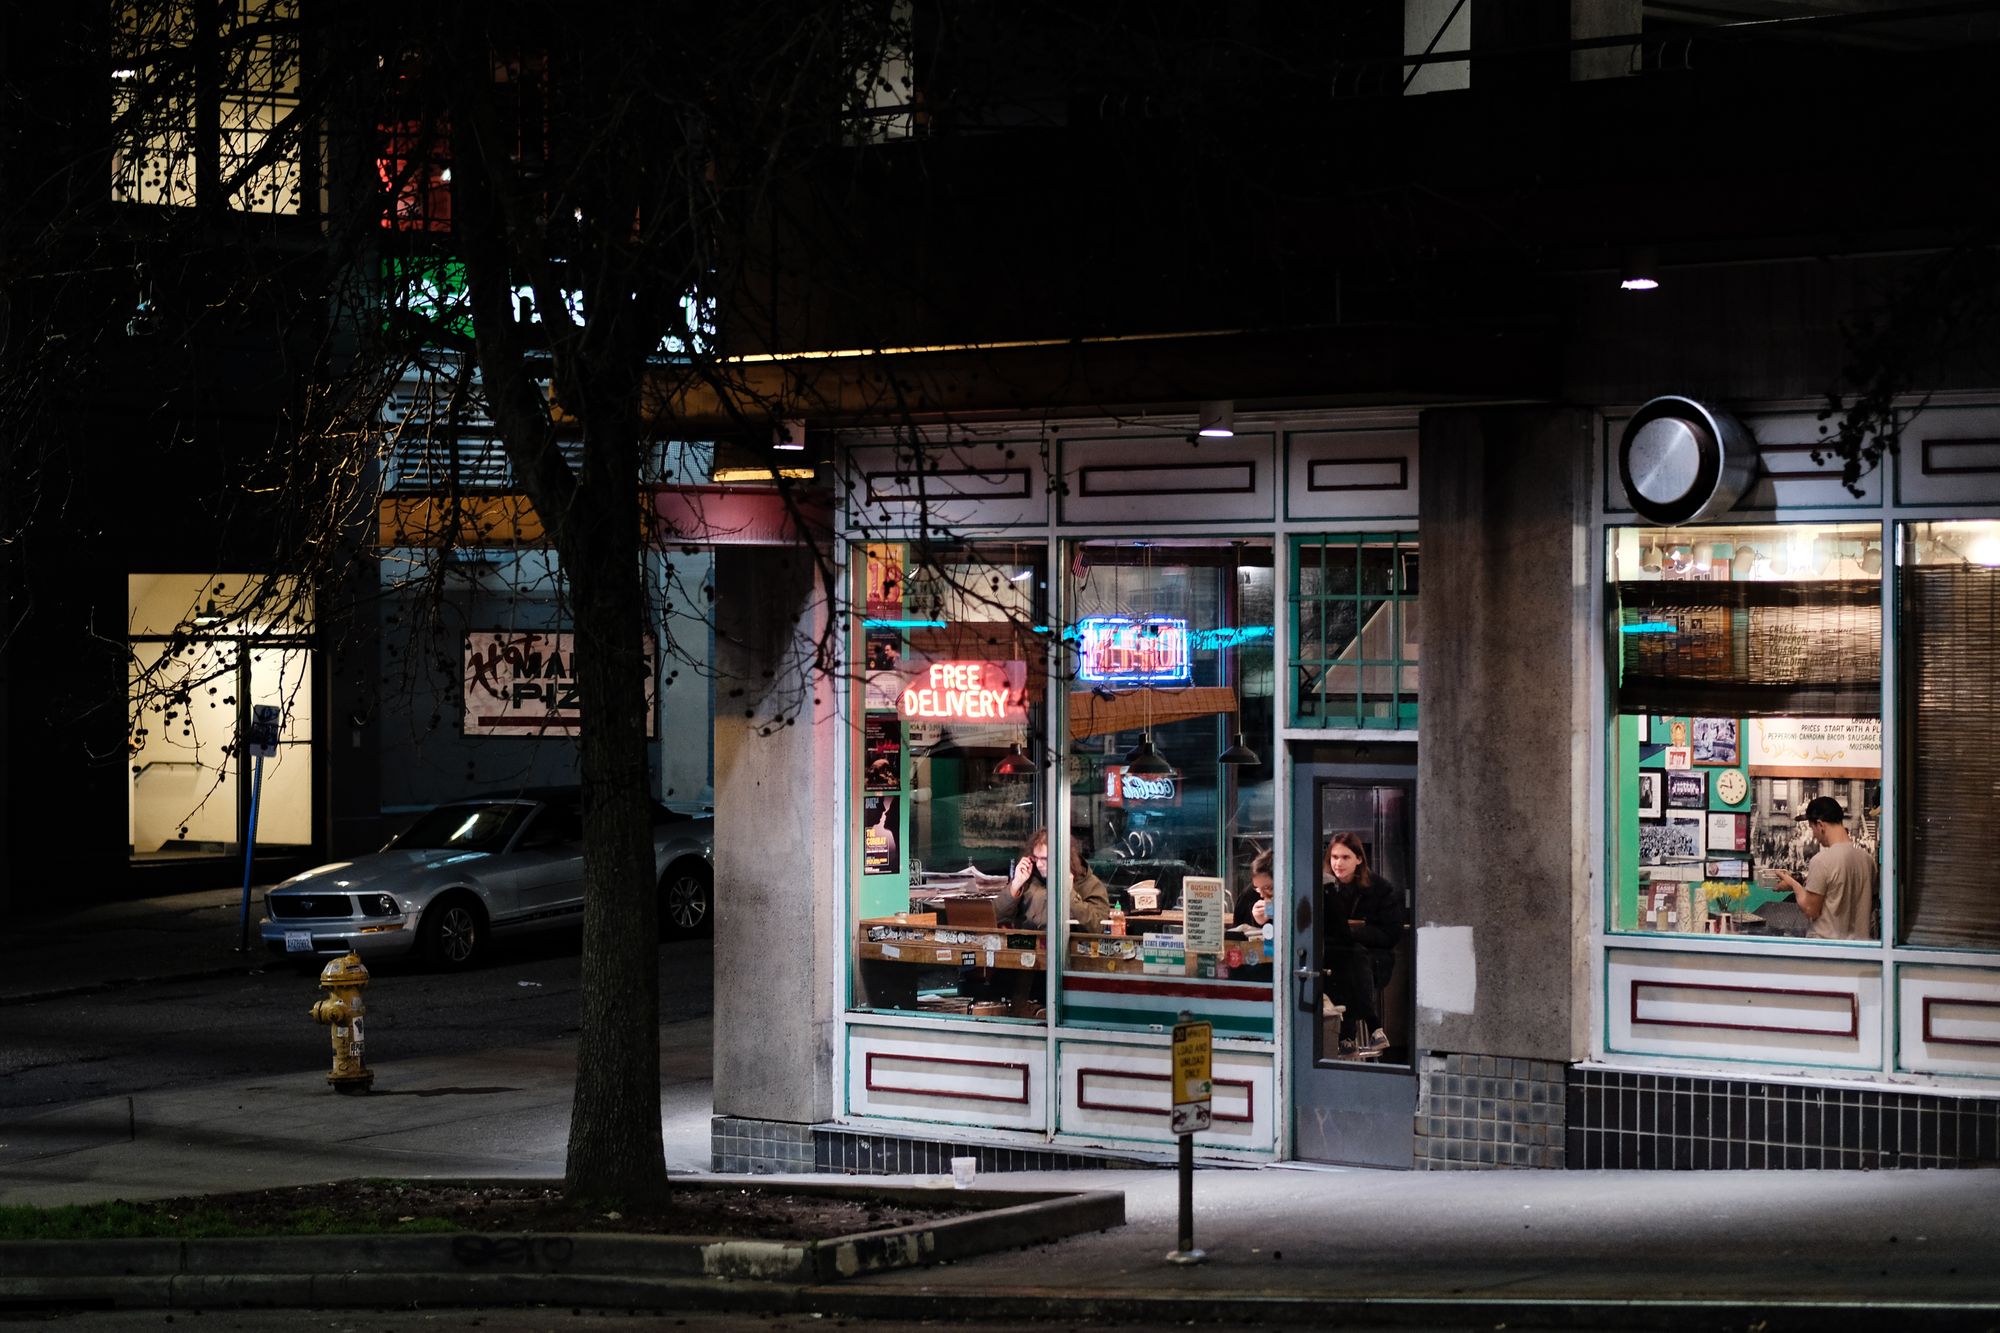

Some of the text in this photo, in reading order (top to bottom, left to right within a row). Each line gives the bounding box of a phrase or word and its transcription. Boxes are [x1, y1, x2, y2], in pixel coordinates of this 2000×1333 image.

[929, 664, 981, 690] FREE
[903, 689, 1009, 718] DELIVERY
[1801, 724, 1821, 732] PRICES
[1824, 724, 1844, 732] START
[1827, 733, 1845, 741] BACON
[1847, 733, 1875, 741] SAUSAGE
[1190, 884, 1218, 892] BUSINESS
[1177, 1043, 1208, 1055] LOAD AND
[1180, 1055, 1205, 1067] UNLOAD
[1184, 1068, 1201, 1079] ONLY
